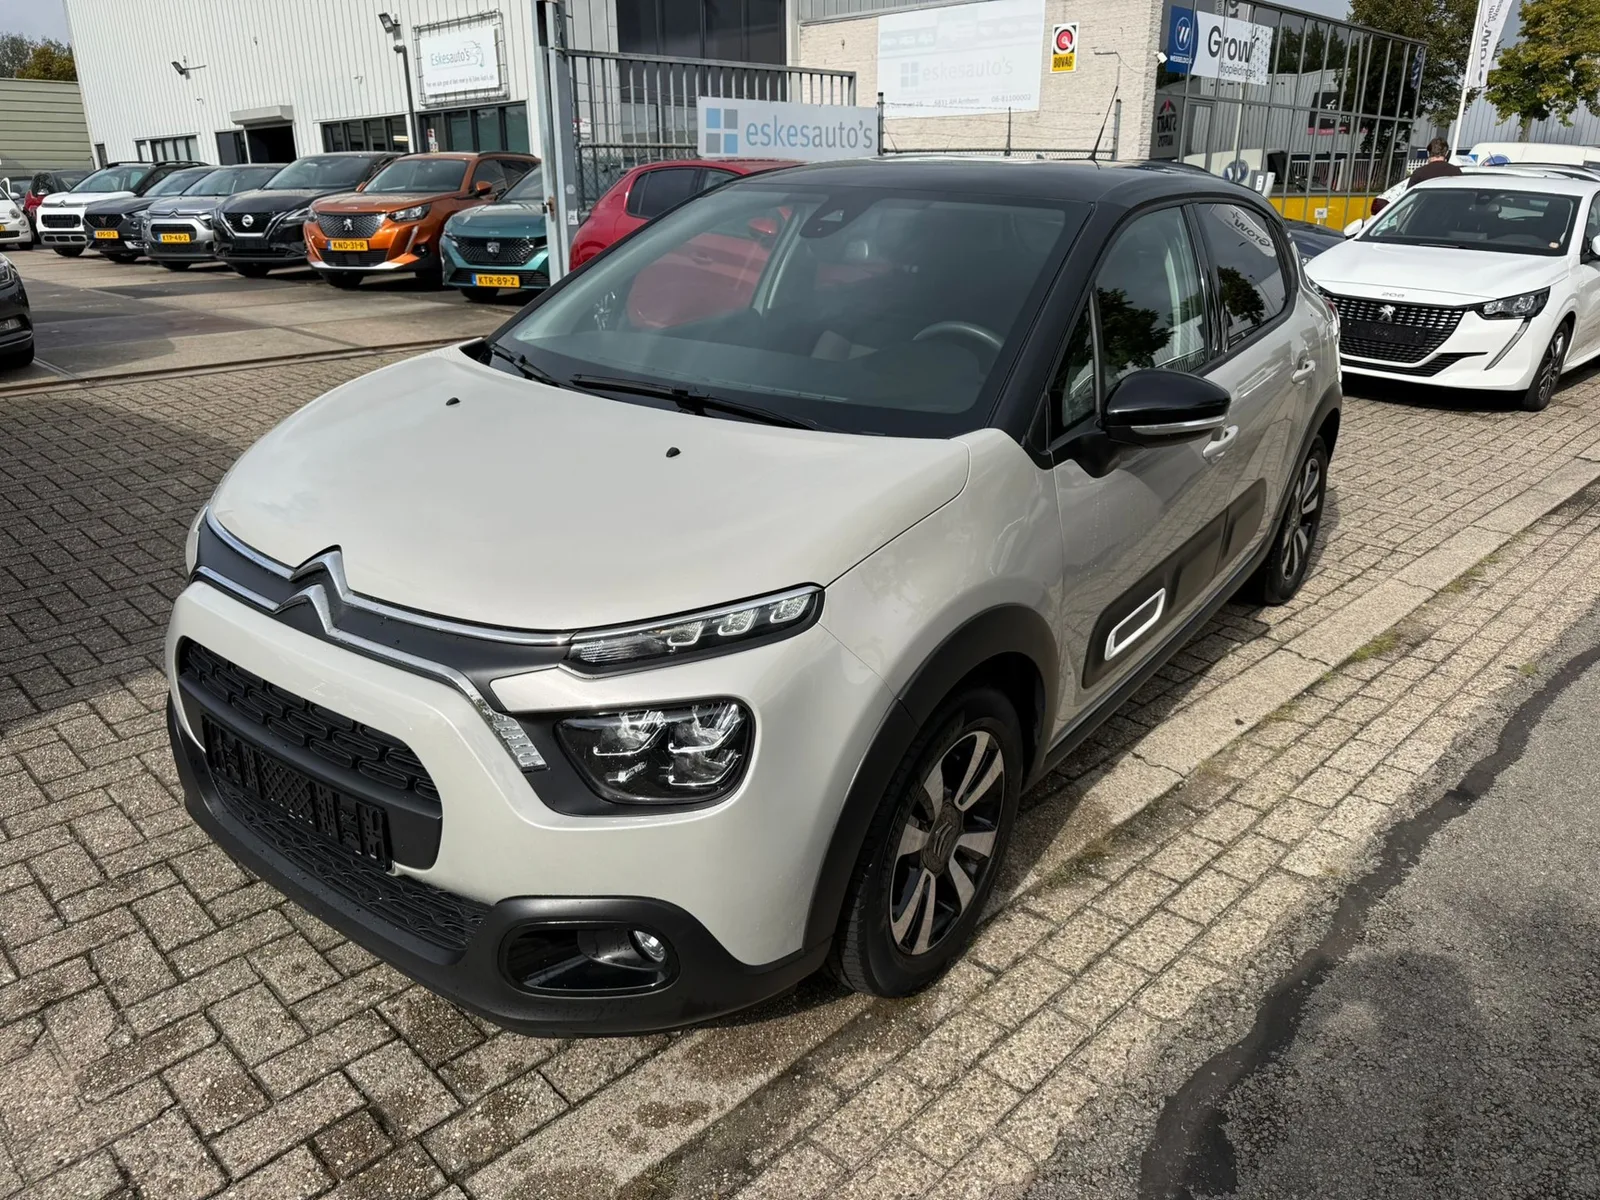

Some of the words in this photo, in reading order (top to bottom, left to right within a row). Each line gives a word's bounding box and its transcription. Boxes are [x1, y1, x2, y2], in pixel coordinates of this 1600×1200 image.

[431, 48, 470, 66] Eskesauto's
[1054, 56, 1073, 68] BOVAG
[922, 56, 1013, 81] eskesauto's
[746, 115, 873, 149] eskesauto's
[333, 241, 366, 249] KND-31-R
[478, 276, 516, 286] KTR-89-Z
